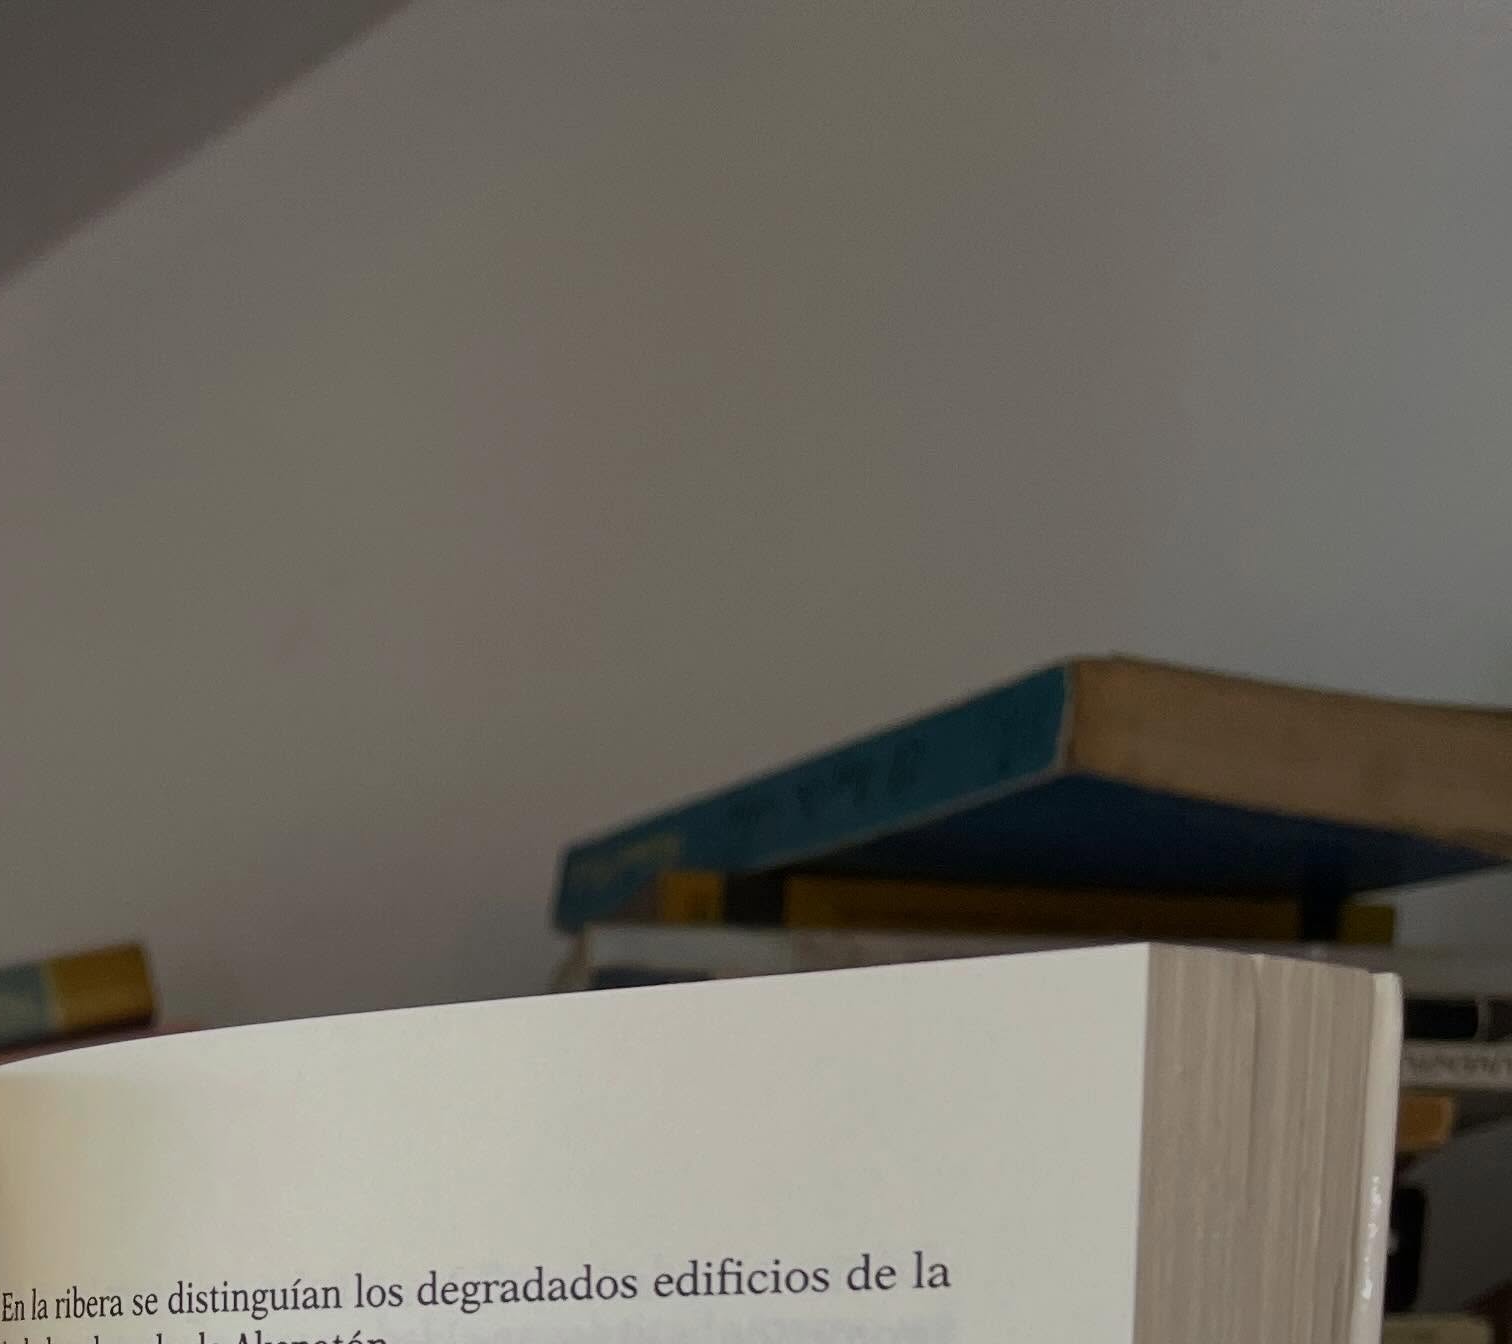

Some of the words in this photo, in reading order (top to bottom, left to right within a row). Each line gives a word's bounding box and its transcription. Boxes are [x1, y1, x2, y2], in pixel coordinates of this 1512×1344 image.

[0, 1291, 26, 1323] En
[31, 1287, 49, 1321] la
[55, 1285, 125, 1320] ribera
[131, 1292, 159, 1317] se
[167, 1278, 343, 1321] distinguían
[353, 1272, 404, 1309] los
[416, 1263, 638, 1315] degradados
[653, 1257, 830, 1298] edificios
[846, 1252, 897, 1292] de
[912, 1250, 952, 1289] la
